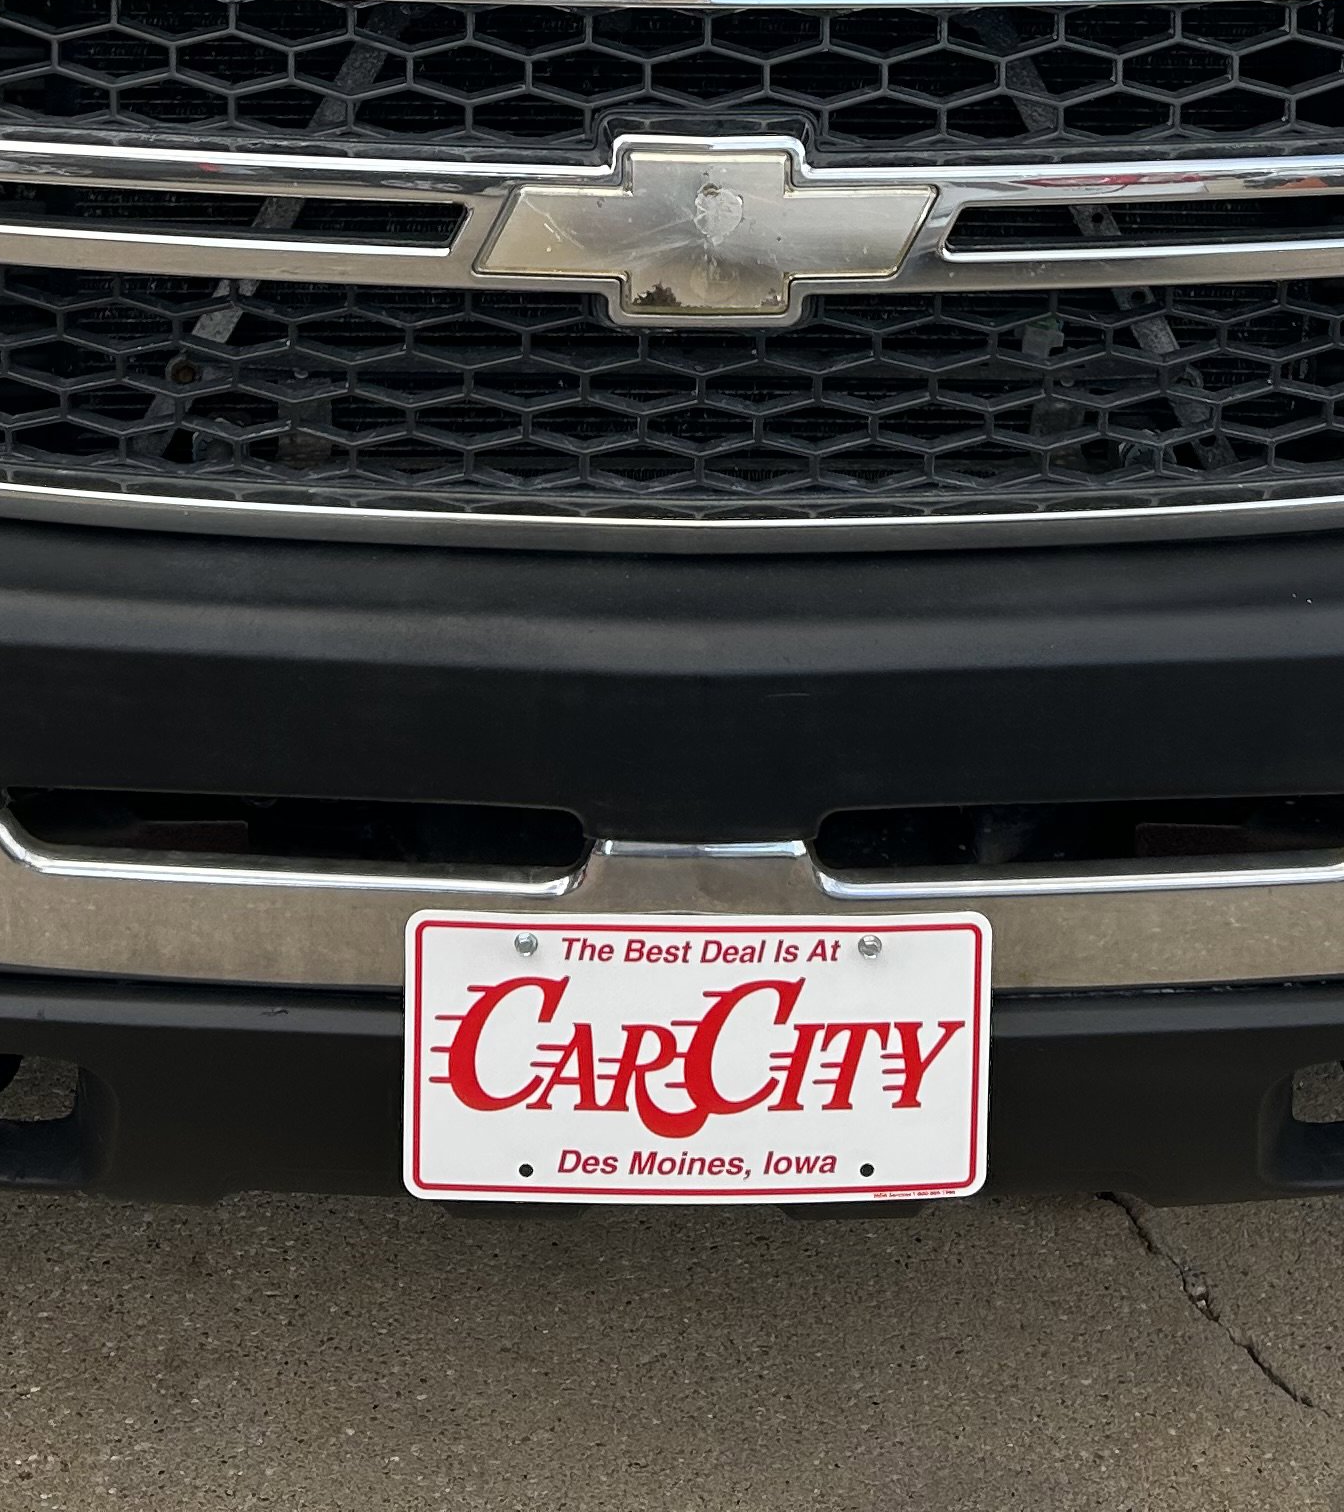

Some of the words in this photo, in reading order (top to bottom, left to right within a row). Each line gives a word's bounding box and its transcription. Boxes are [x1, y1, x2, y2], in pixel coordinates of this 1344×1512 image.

[561, 937, 614, 963] The
[623, 940, 690, 964] Best
[700, 940, 765, 964] Deal
[774, 941, 800, 964] Is
[807, 940, 841, 963] At
[557, 1150, 619, 1176] Des
[628, 1151, 752, 1180] Moines,
[762, 1151, 837, 1176] Iowa
